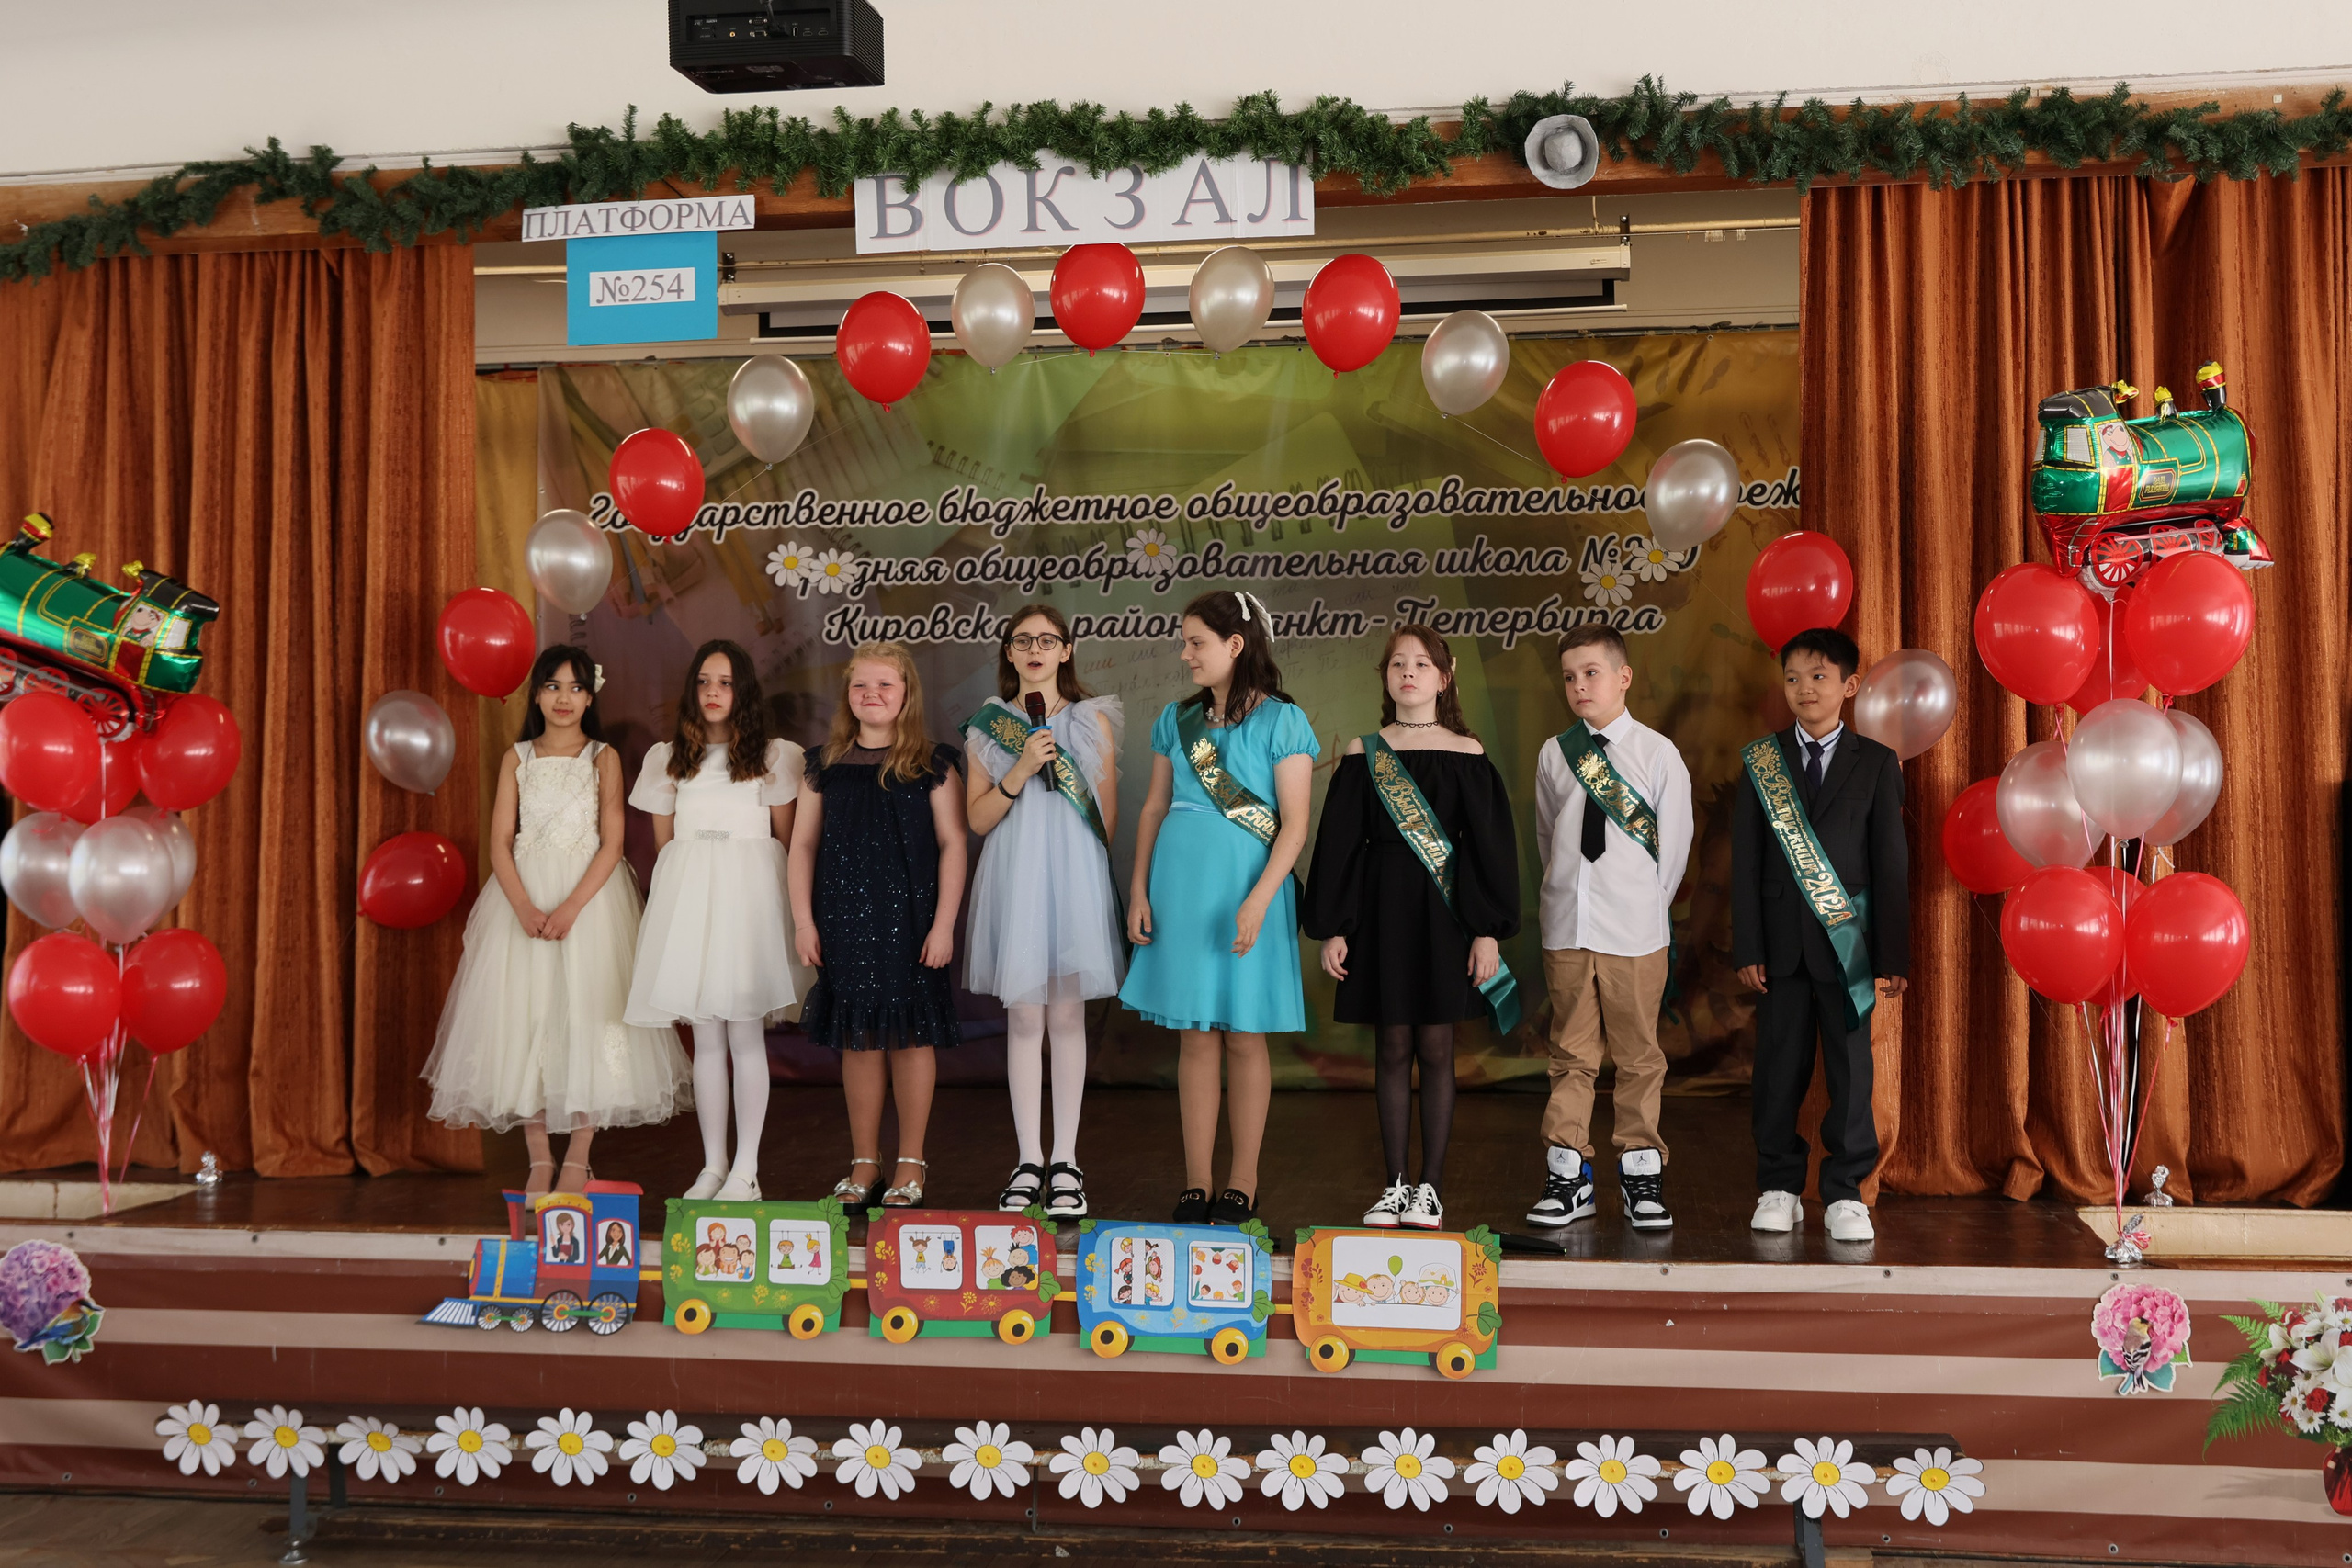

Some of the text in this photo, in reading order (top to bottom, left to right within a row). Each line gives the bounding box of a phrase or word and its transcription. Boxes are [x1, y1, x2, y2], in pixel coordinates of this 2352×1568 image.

[523, 199, 753, 240] ПЛАТФОРМА
[869, 157, 1310, 239] ВОКЗАЛ
[596, 273, 684, 304] №254
[938, 486, 1180, 536] бюджетное
[1434, 536, 1569, 575] школа
[1762, 773, 1853, 927] Выпускник 2024
